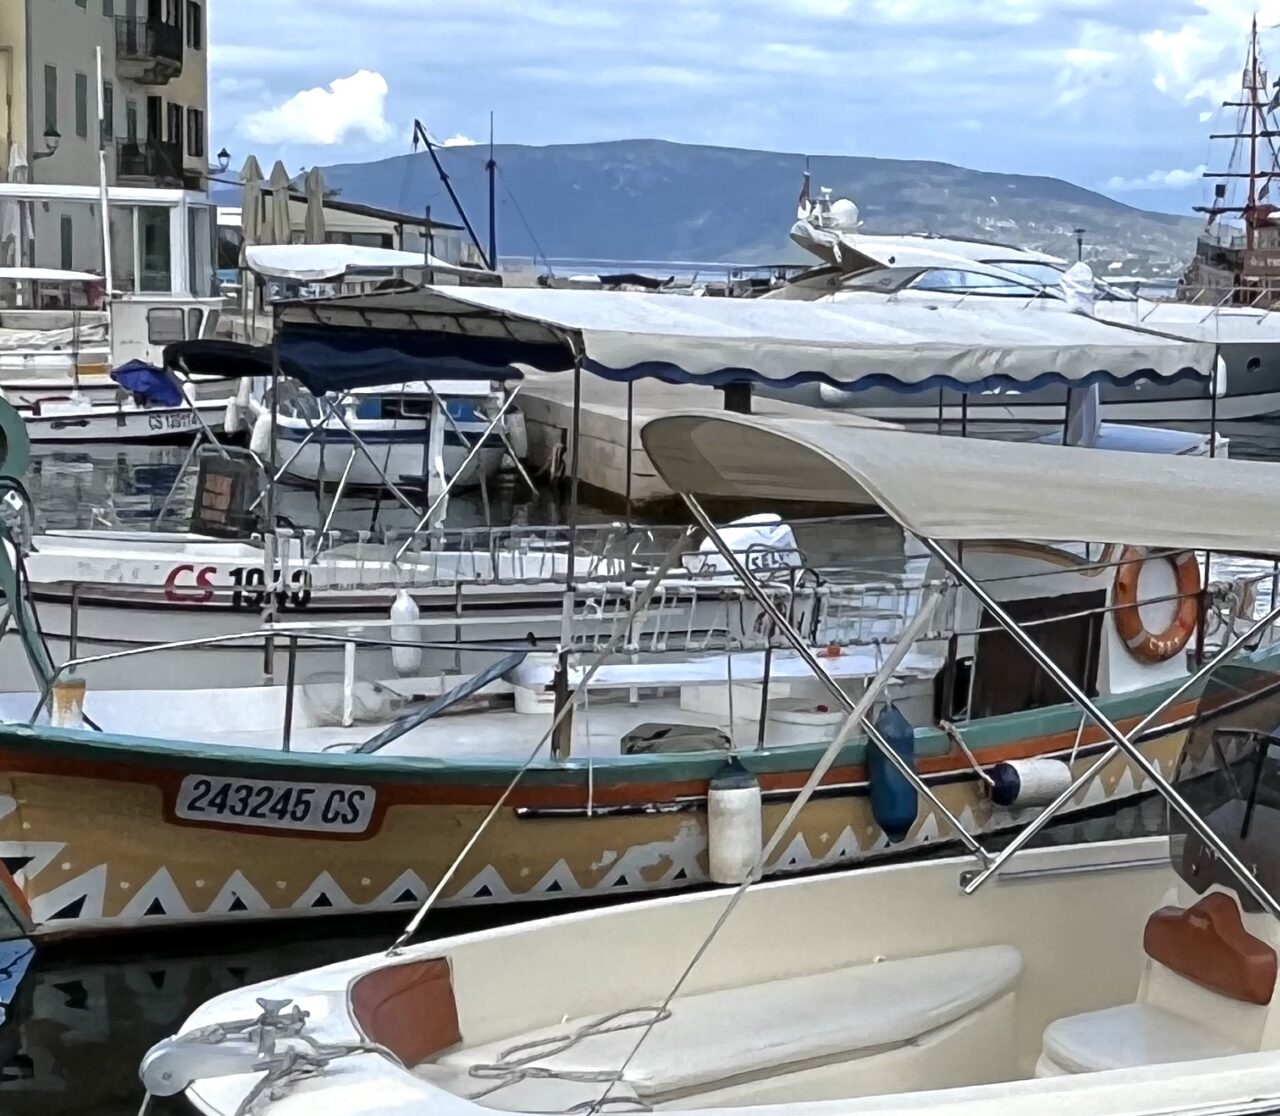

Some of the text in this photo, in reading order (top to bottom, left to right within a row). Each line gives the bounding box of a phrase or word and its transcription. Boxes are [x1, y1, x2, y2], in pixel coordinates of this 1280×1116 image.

[165, 564, 217, 603] CS
[187, 779, 365, 824] 243245 CS
